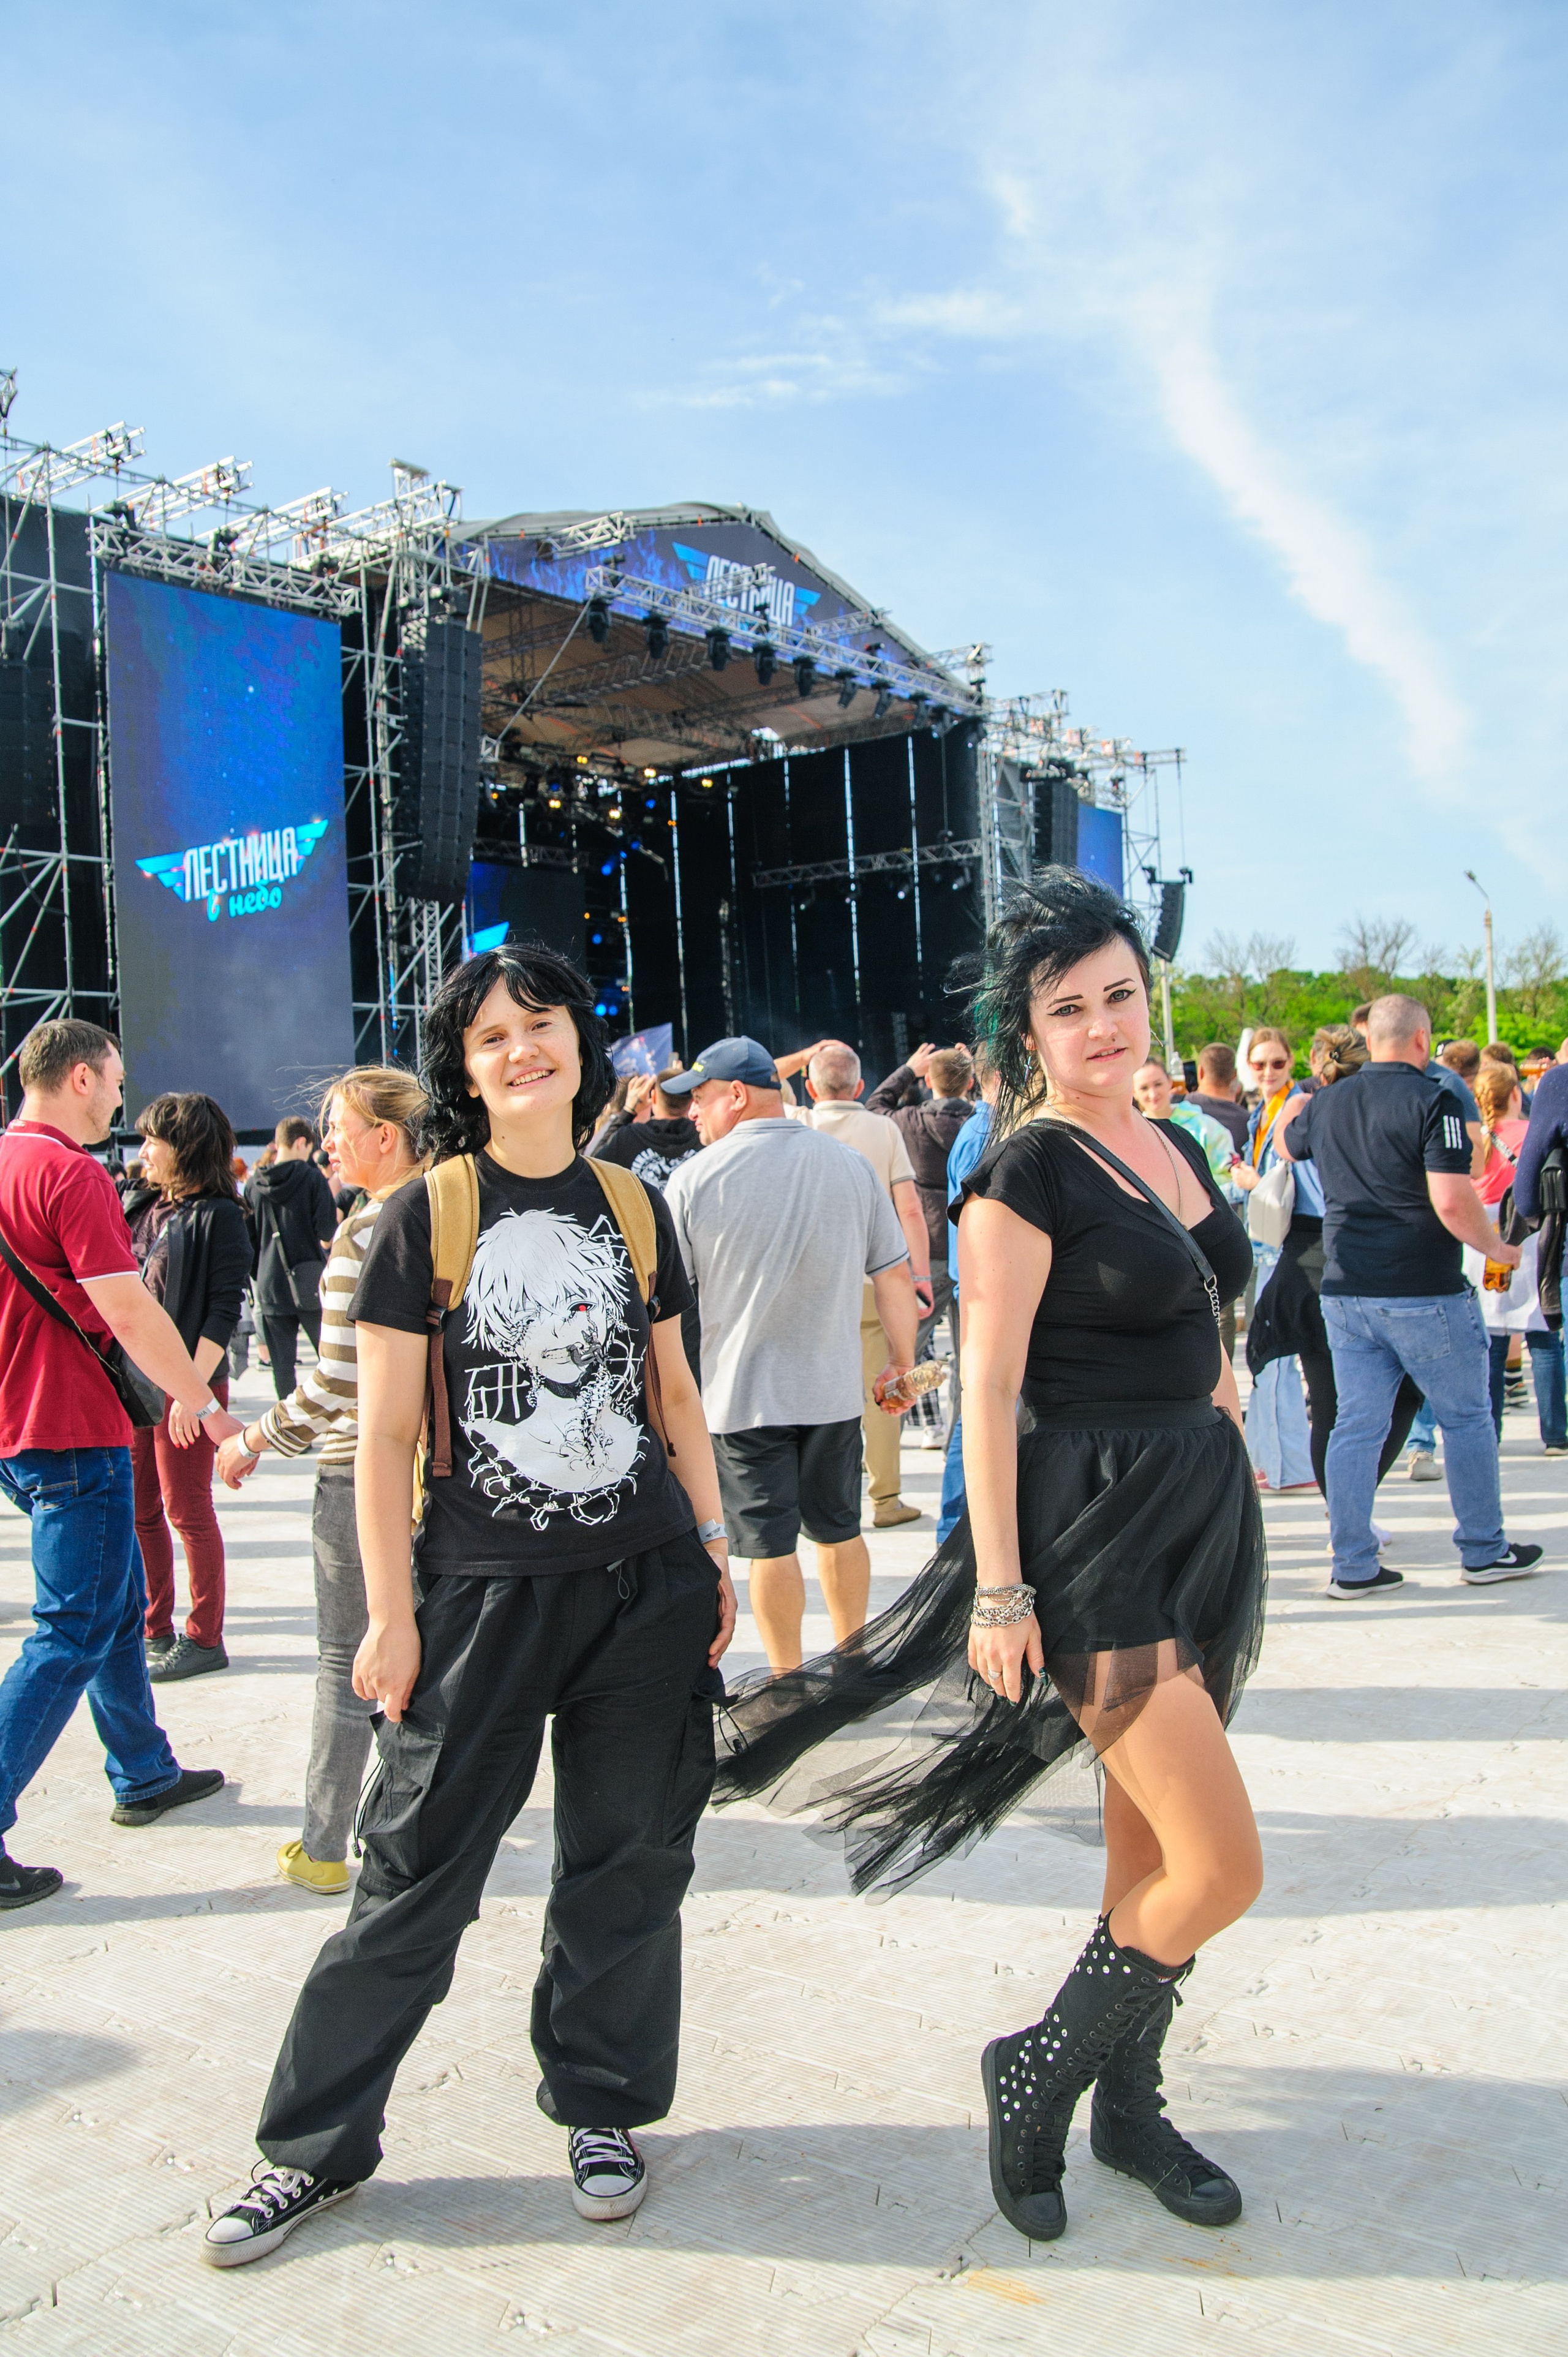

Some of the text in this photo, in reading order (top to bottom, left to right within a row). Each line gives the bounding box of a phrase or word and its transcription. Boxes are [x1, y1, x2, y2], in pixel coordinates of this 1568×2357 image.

[184, 827, 298, 902] ЛЕСТНИЦА
[207, 880, 282, 922] в небо
[464, 1359, 530, 1424] 研
